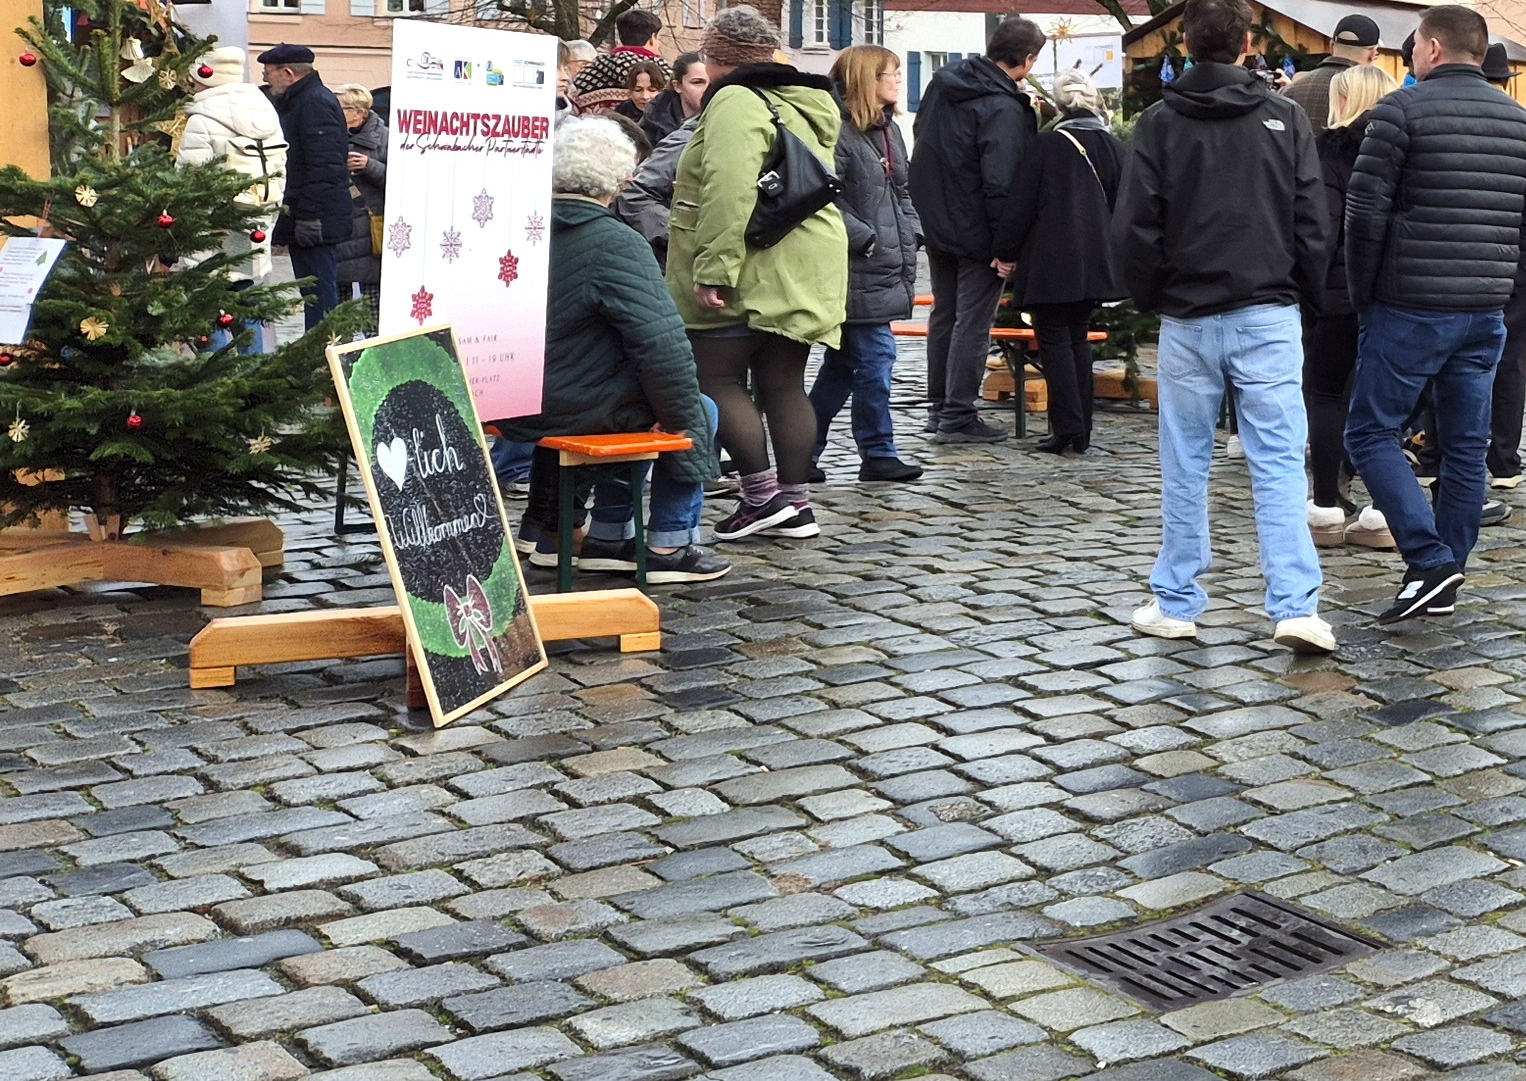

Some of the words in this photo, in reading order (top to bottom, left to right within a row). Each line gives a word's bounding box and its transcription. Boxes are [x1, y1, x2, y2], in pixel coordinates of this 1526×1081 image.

[397, 108, 550, 140] WEINACHTSZAUBER
[400, 132, 415, 151] der
[458, 336, 472, 344] SAM
[499, 352, 515, 362] UHR
